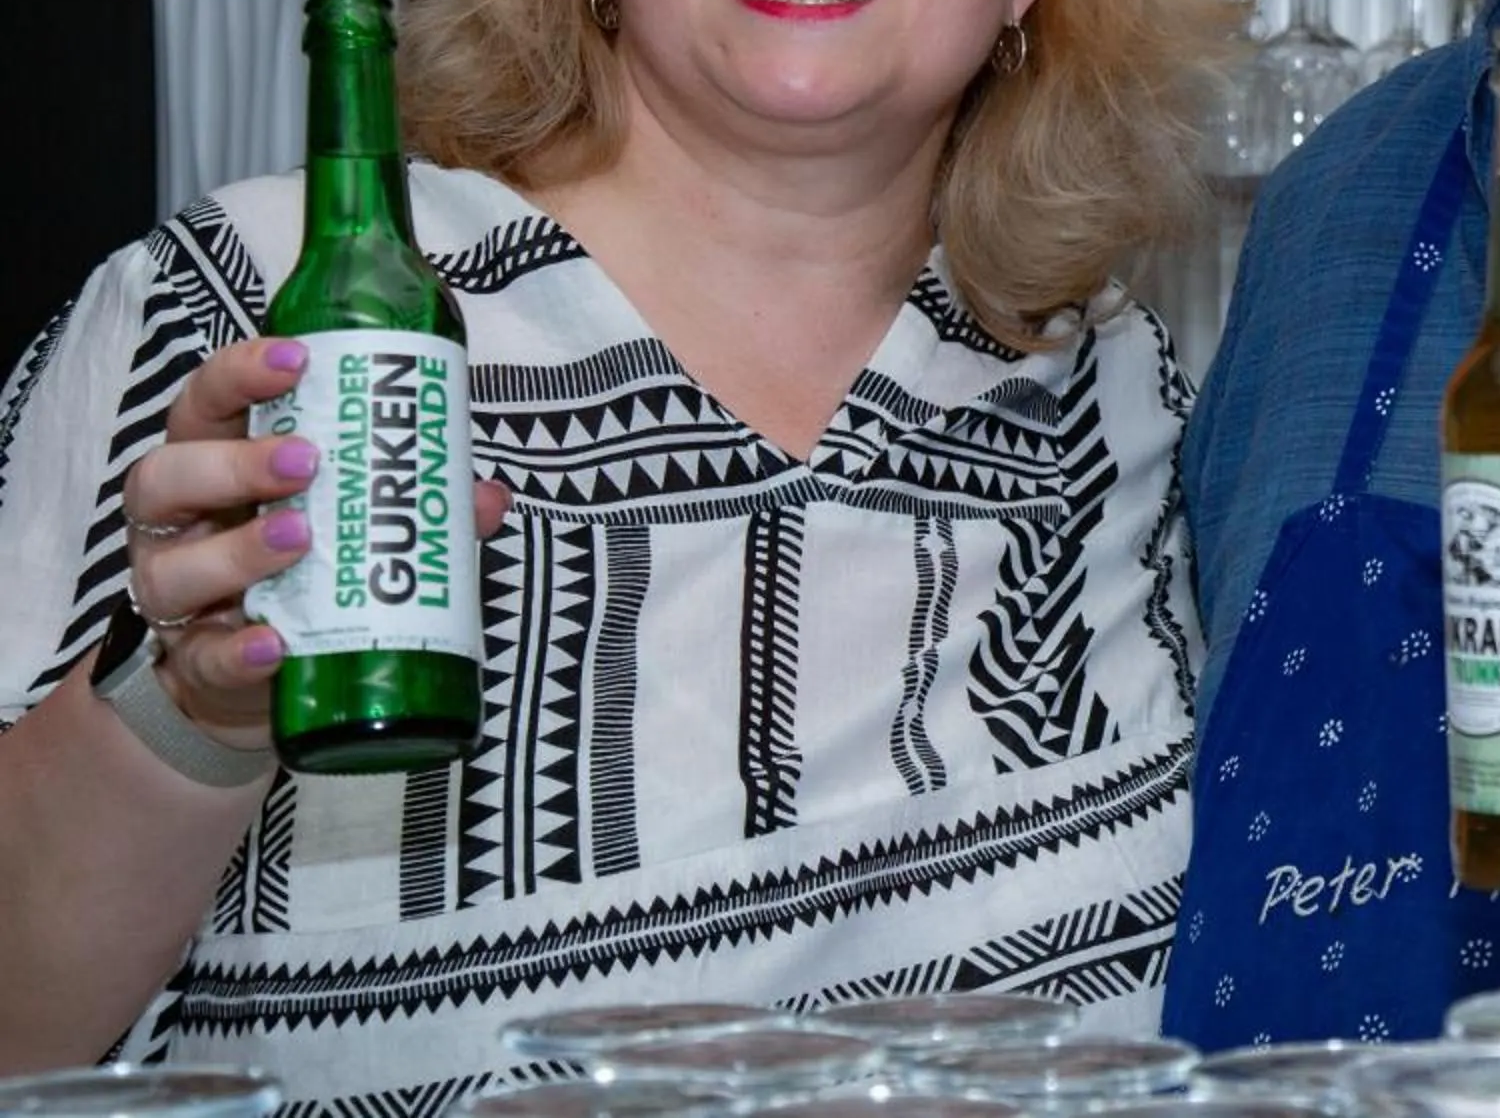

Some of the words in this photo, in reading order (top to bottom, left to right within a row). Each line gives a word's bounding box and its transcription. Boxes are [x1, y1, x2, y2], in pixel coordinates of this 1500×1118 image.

[328, 353, 370, 609] SPREEWÄLDER
[369, 352, 418, 606] GURKEN
[417, 355, 450, 610] LIMONADE
[1259, 855, 1421, 925] Peter
